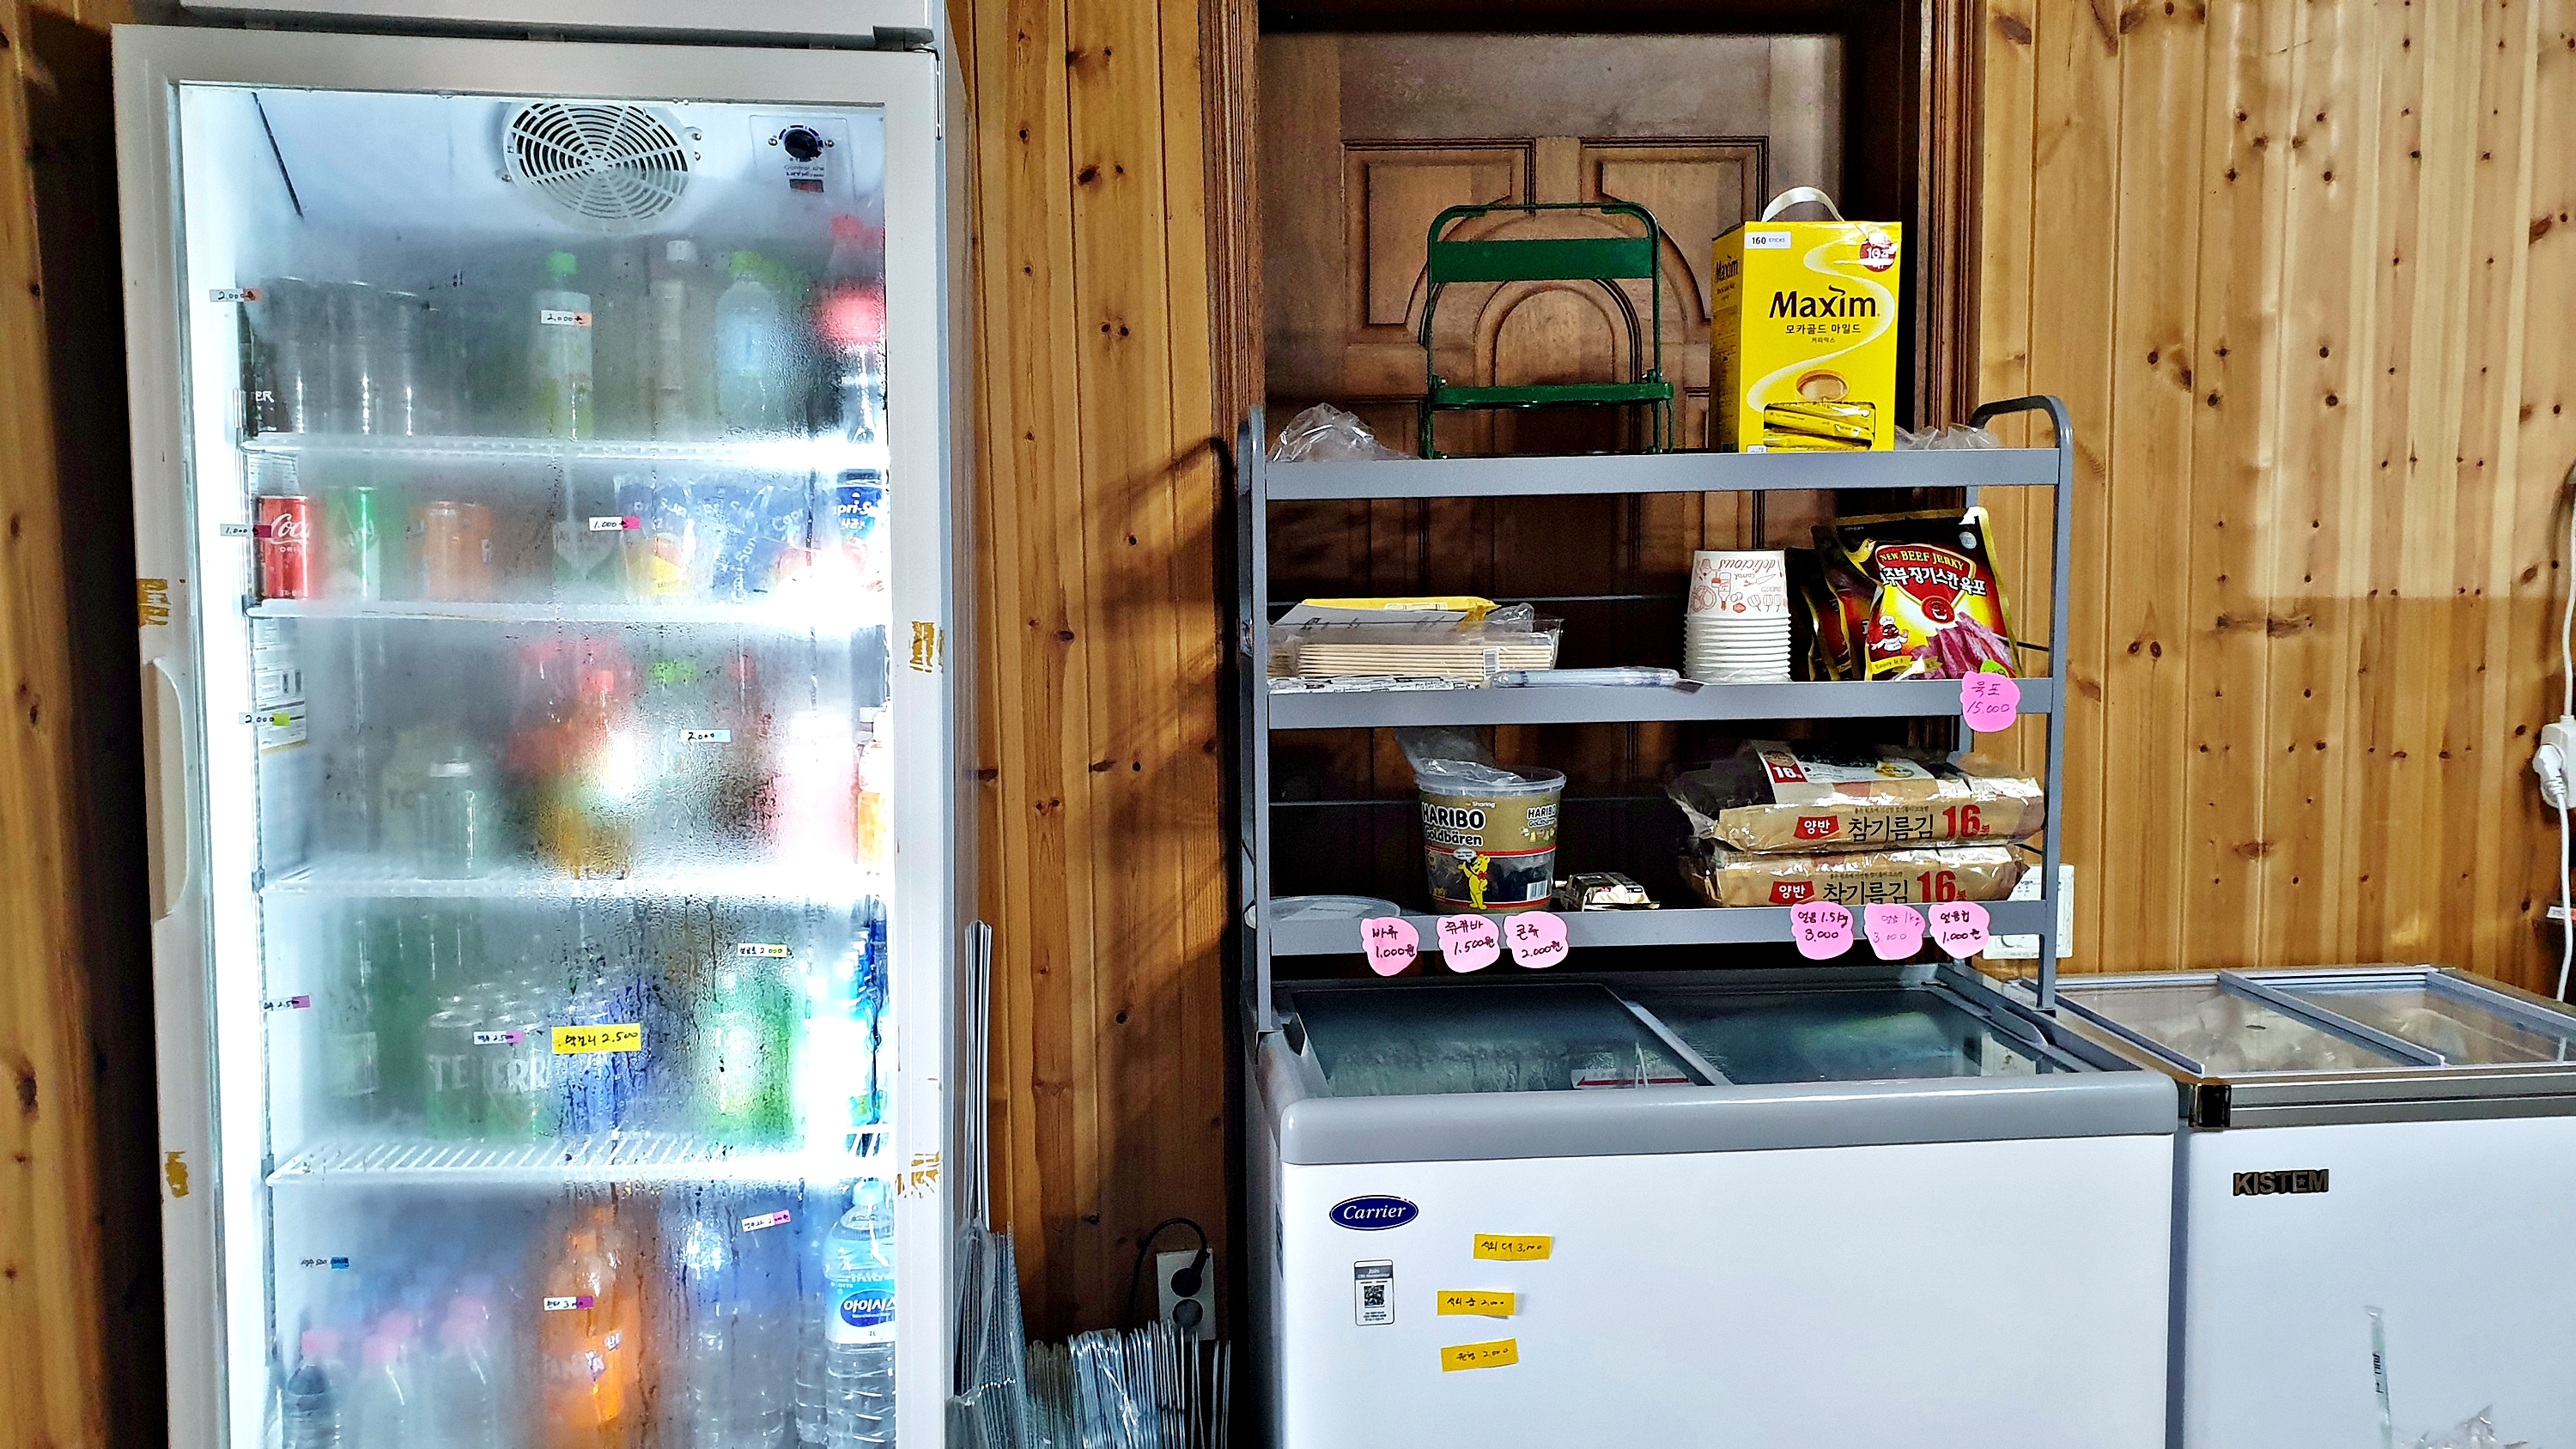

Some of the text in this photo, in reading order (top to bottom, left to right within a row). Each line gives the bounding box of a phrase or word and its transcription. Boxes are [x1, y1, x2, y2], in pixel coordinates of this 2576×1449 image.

[1752, 236, 1766, 245] 160
[1769, 285, 1877, 318] Maxim
[1785, 324, 1862, 335] 모카골드 마일드
[1719, 560, 1776, 573] delicious
[1880, 550, 1964, 571] NEW BEEF JERKY
[1908, 568, 1959, 591] 징기스칸
[1959, 577, 1986, 596] 육포
[1971, 681, 2001, 698] 육포
[1422, 802, 1485, 831] HARIBO
[1425, 825, 1484, 847] Goldbären
[1804, 819, 1831, 834] 양반
[1848, 814, 1934, 842] 참기름김
[1778, 884, 1806, 899] 양반
[1822, 879, 1909, 904] 참기름김
[2234, 1170, 2329, 1195] KISTEM
[1343, 1204, 1406, 1220] Carrier
